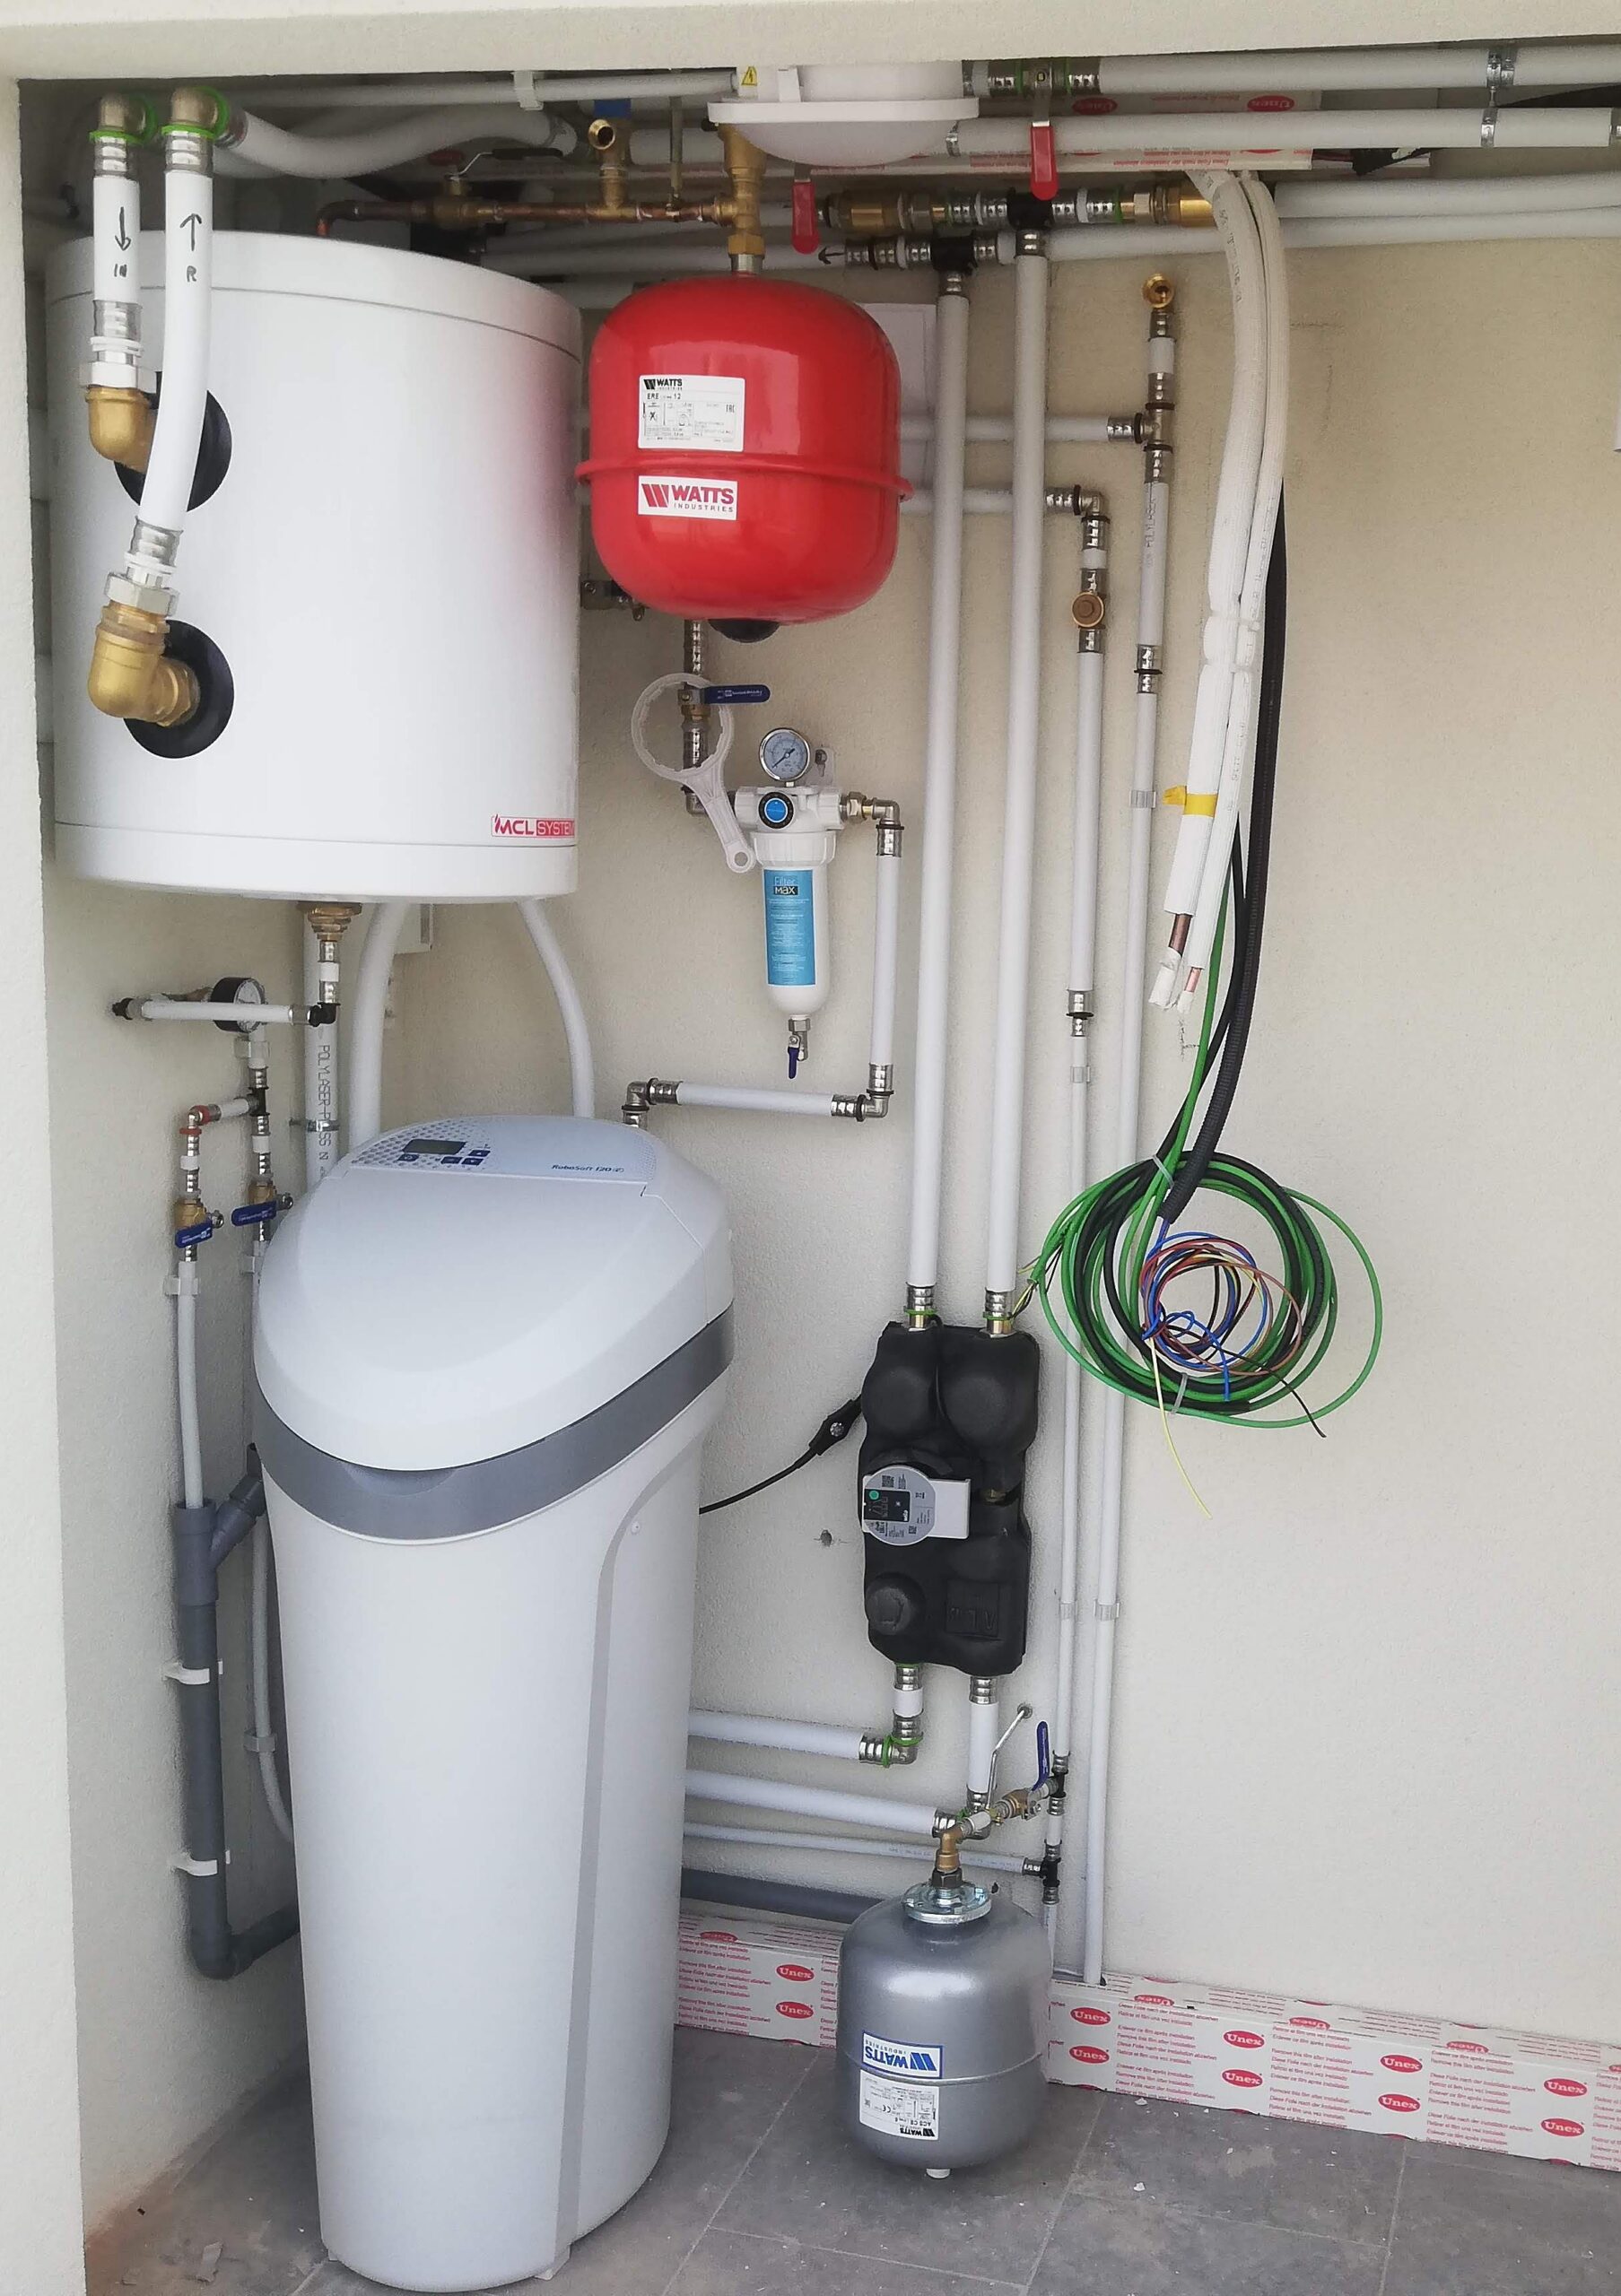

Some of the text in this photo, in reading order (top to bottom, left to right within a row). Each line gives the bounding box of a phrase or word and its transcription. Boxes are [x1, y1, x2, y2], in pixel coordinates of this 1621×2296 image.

[186, 265, 196, 283] R
[657, 378, 683, 387] WATTS
[671, 485, 734, 504] WATTS
[674, 502, 734, 512] INDUSTRIES
[779, 1967, 812, 1979] Unex
[778, 2004, 812, 2016] Unex
[1072, 2010, 1109, 2023] Unex
[1226, 2032, 1263, 2047] Unex
[865, 2046, 909, 2069] WATTS
[1072, 2048, 1108, 2061] Unex
[1383, 2057, 1421, 2070] Unex
[1224, 2071, 1261, 2085] Unex
[1546, 2081, 1585, 2095] Unex
[1381, 2096, 1418, 2109] Unex
[900, 2126, 922, 2136] WATTS
[1544, 2120, 1582, 2135] Unex
